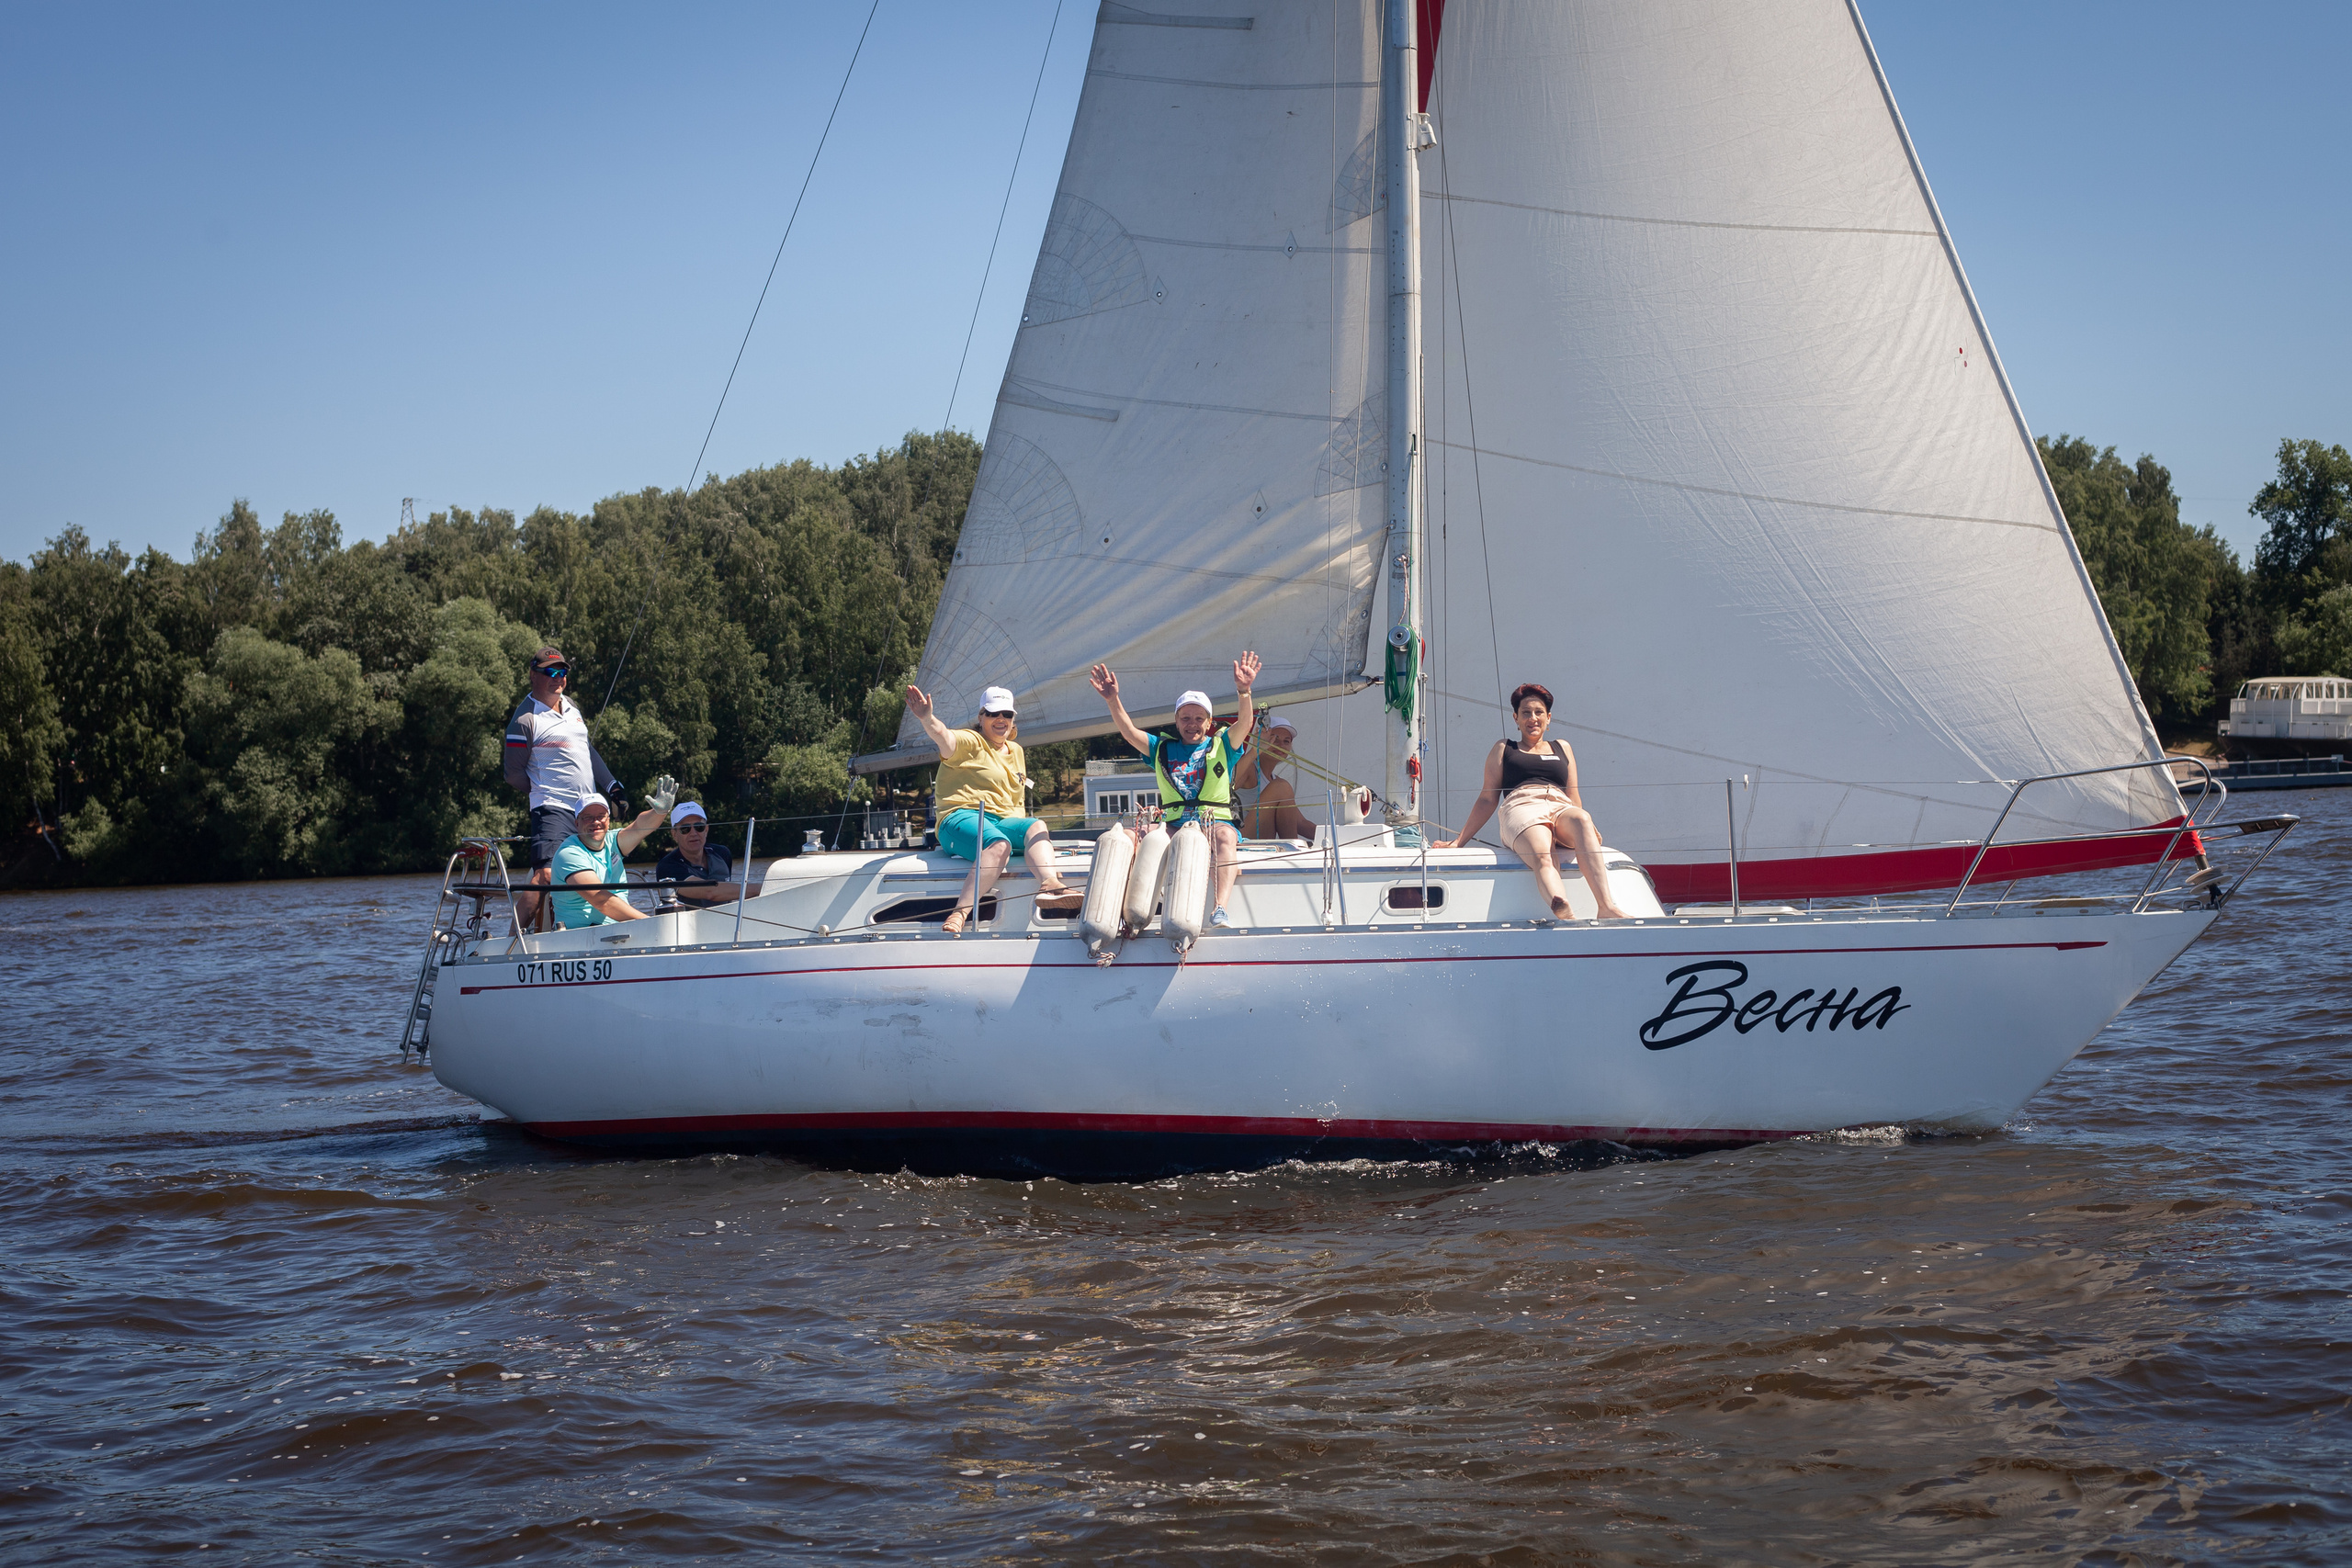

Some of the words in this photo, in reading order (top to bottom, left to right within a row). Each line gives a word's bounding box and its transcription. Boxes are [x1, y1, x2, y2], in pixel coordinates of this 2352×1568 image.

[517, 963, 545, 984] 071
[551, 960, 587, 983] RUS
[593, 959, 612, 981] 50
[1639, 960, 1912, 1051] Весна
